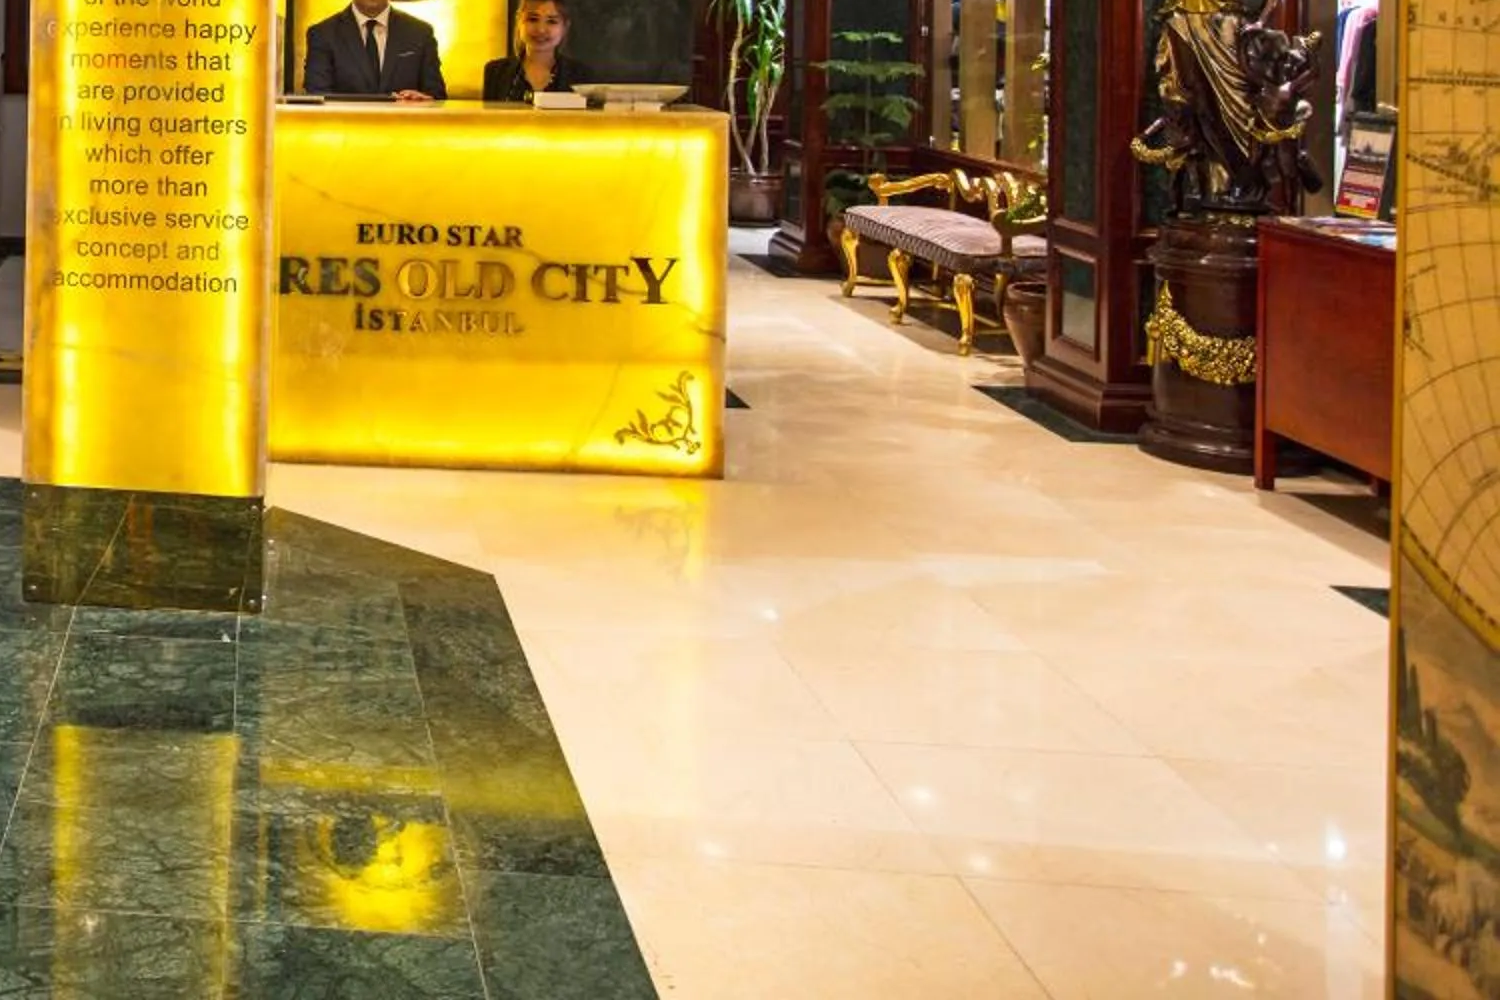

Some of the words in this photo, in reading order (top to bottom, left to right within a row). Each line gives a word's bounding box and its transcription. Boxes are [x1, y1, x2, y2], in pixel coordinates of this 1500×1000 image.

[184, 18, 257, 45] happy
[70, 52, 178, 70] moments
[186, 51, 232, 71] that
[77, 84, 115, 100] are
[123, 82, 226, 105] provided
[80, 111, 142, 137] living
[149, 114, 248, 136] quarters
[85, 143, 152, 165] which
[159, 144, 215, 166] offer
[89, 178, 149, 197] more
[156, 176, 208, 198] than
[164, 209, 250, 230] service
[356, 222, 439, 246] EURO
[446, 224, 524, 249] STAR
[76, 239, 168, 263] concept
[175, 241, 220, 261] and
[51, 269, 237, 293] accommodation
[276, 255, 382, 298] RES
[394, 257, 517, 301] OLD
[530, 255, 678, 305] CITY
